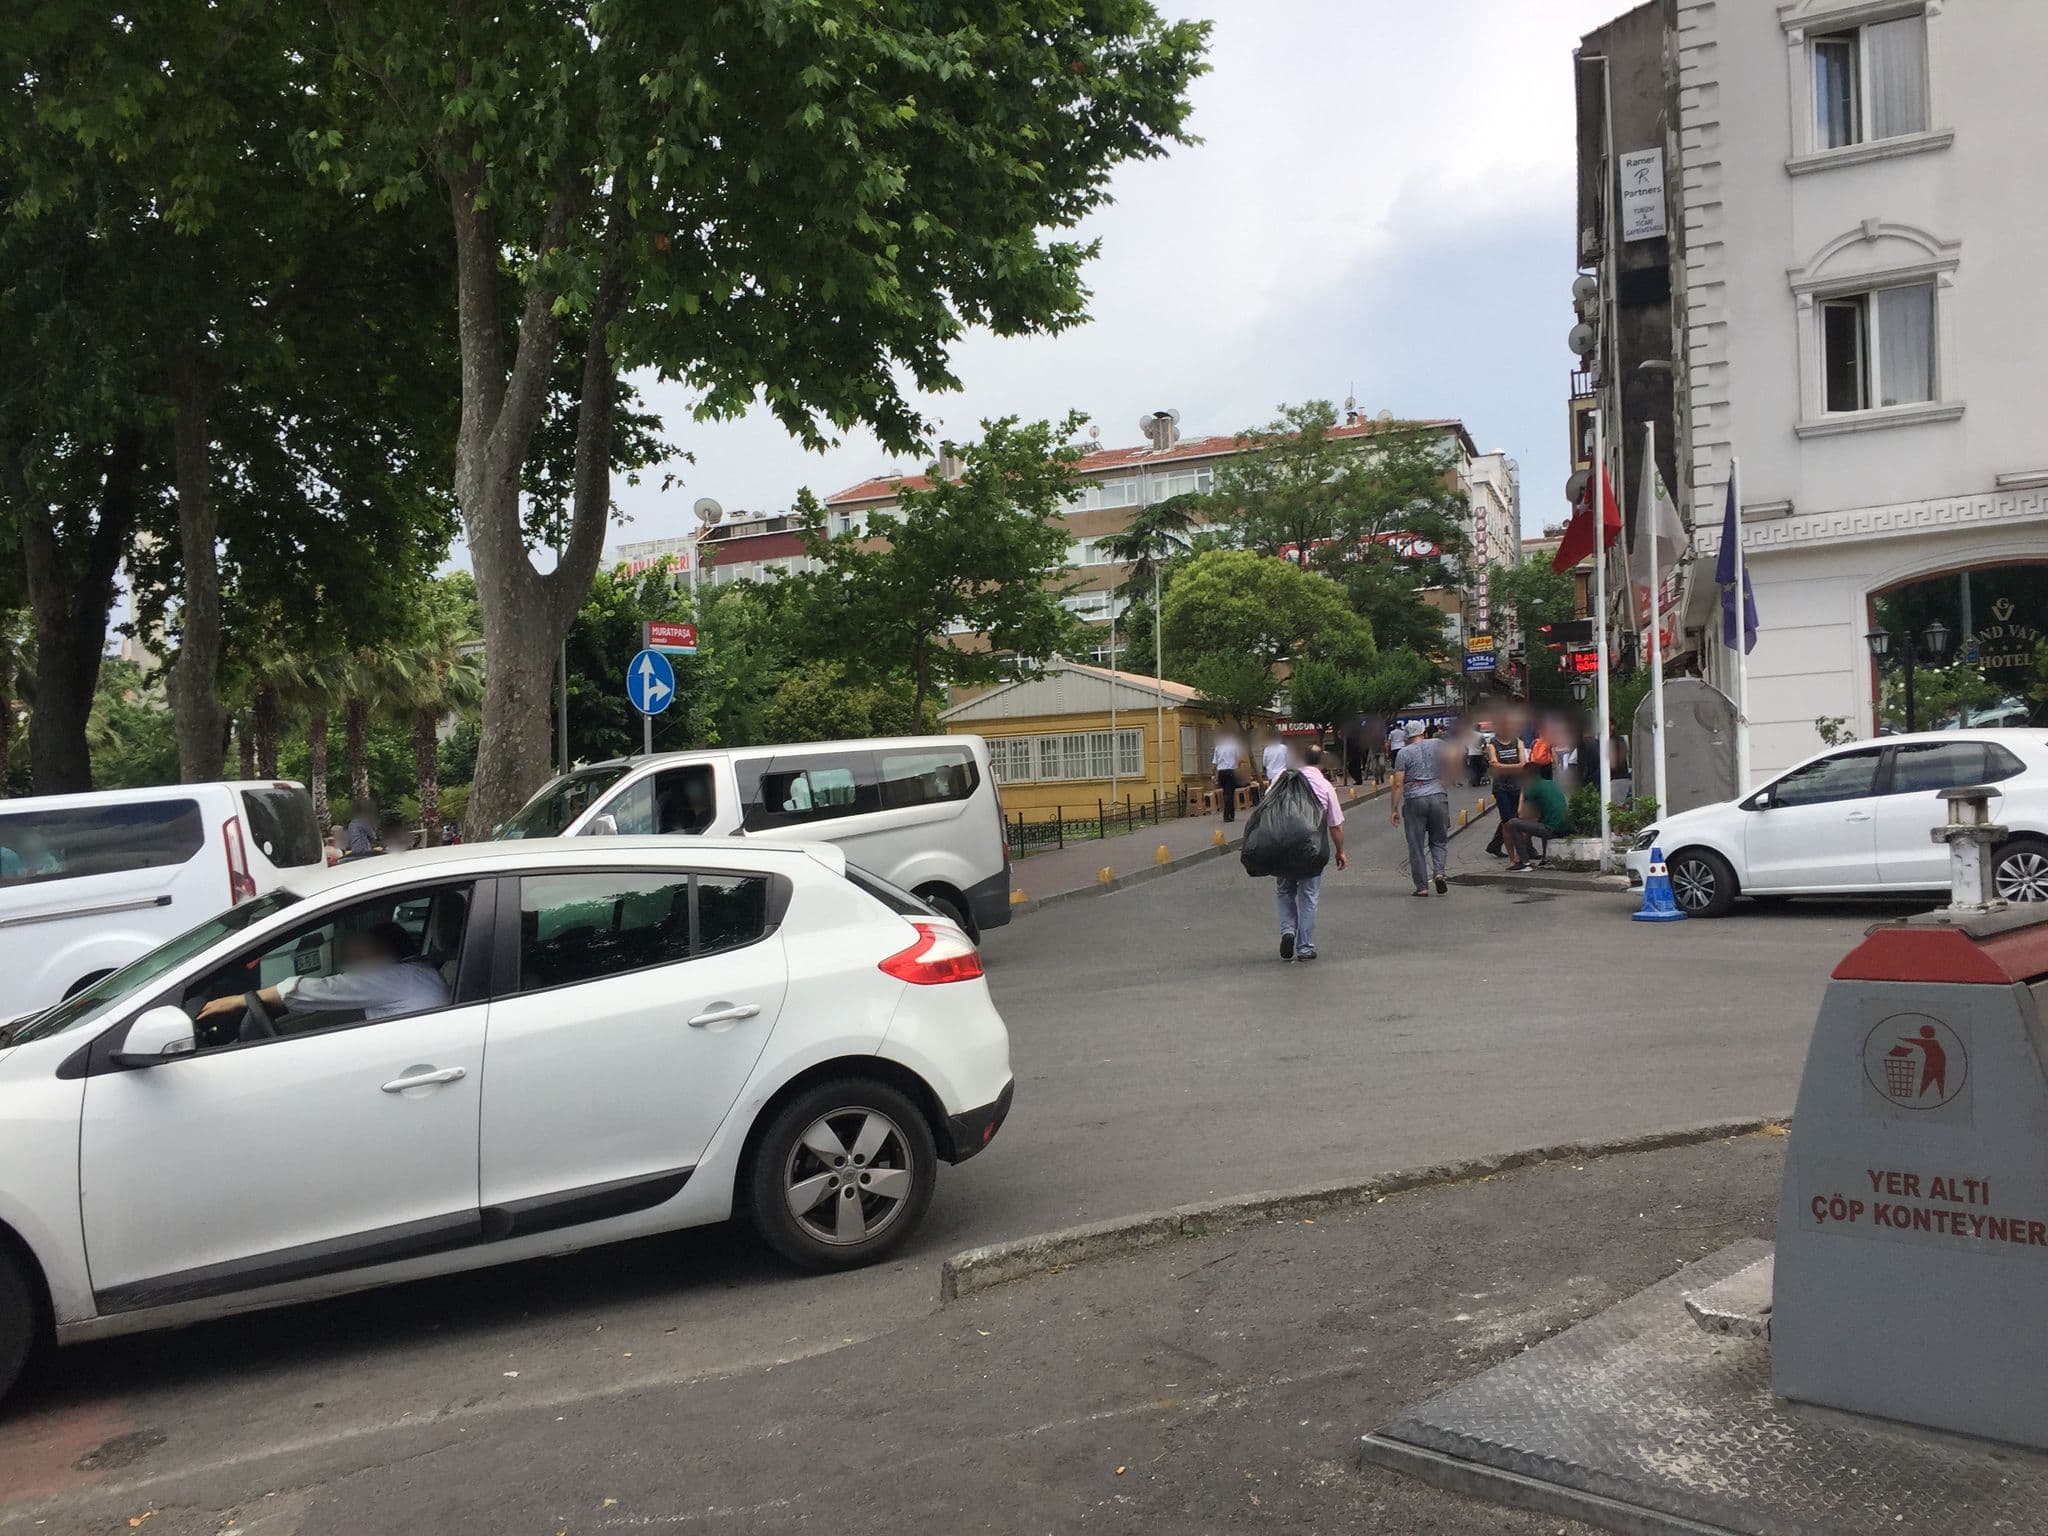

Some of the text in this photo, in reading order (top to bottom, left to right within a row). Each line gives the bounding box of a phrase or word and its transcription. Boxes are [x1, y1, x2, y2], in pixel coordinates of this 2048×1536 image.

[1626, 156, 1655, 168] Ramer
[1624, 185, 1662, 199] Partners
[651, 626, 691, 639] MURATPAŞA
[1979, 653, 2034, 668] HOTEL
[1867, 1169, 1920, 1198] YER
[1811, 1193, 2048, 1247] ÇÖP KONTEYNER
